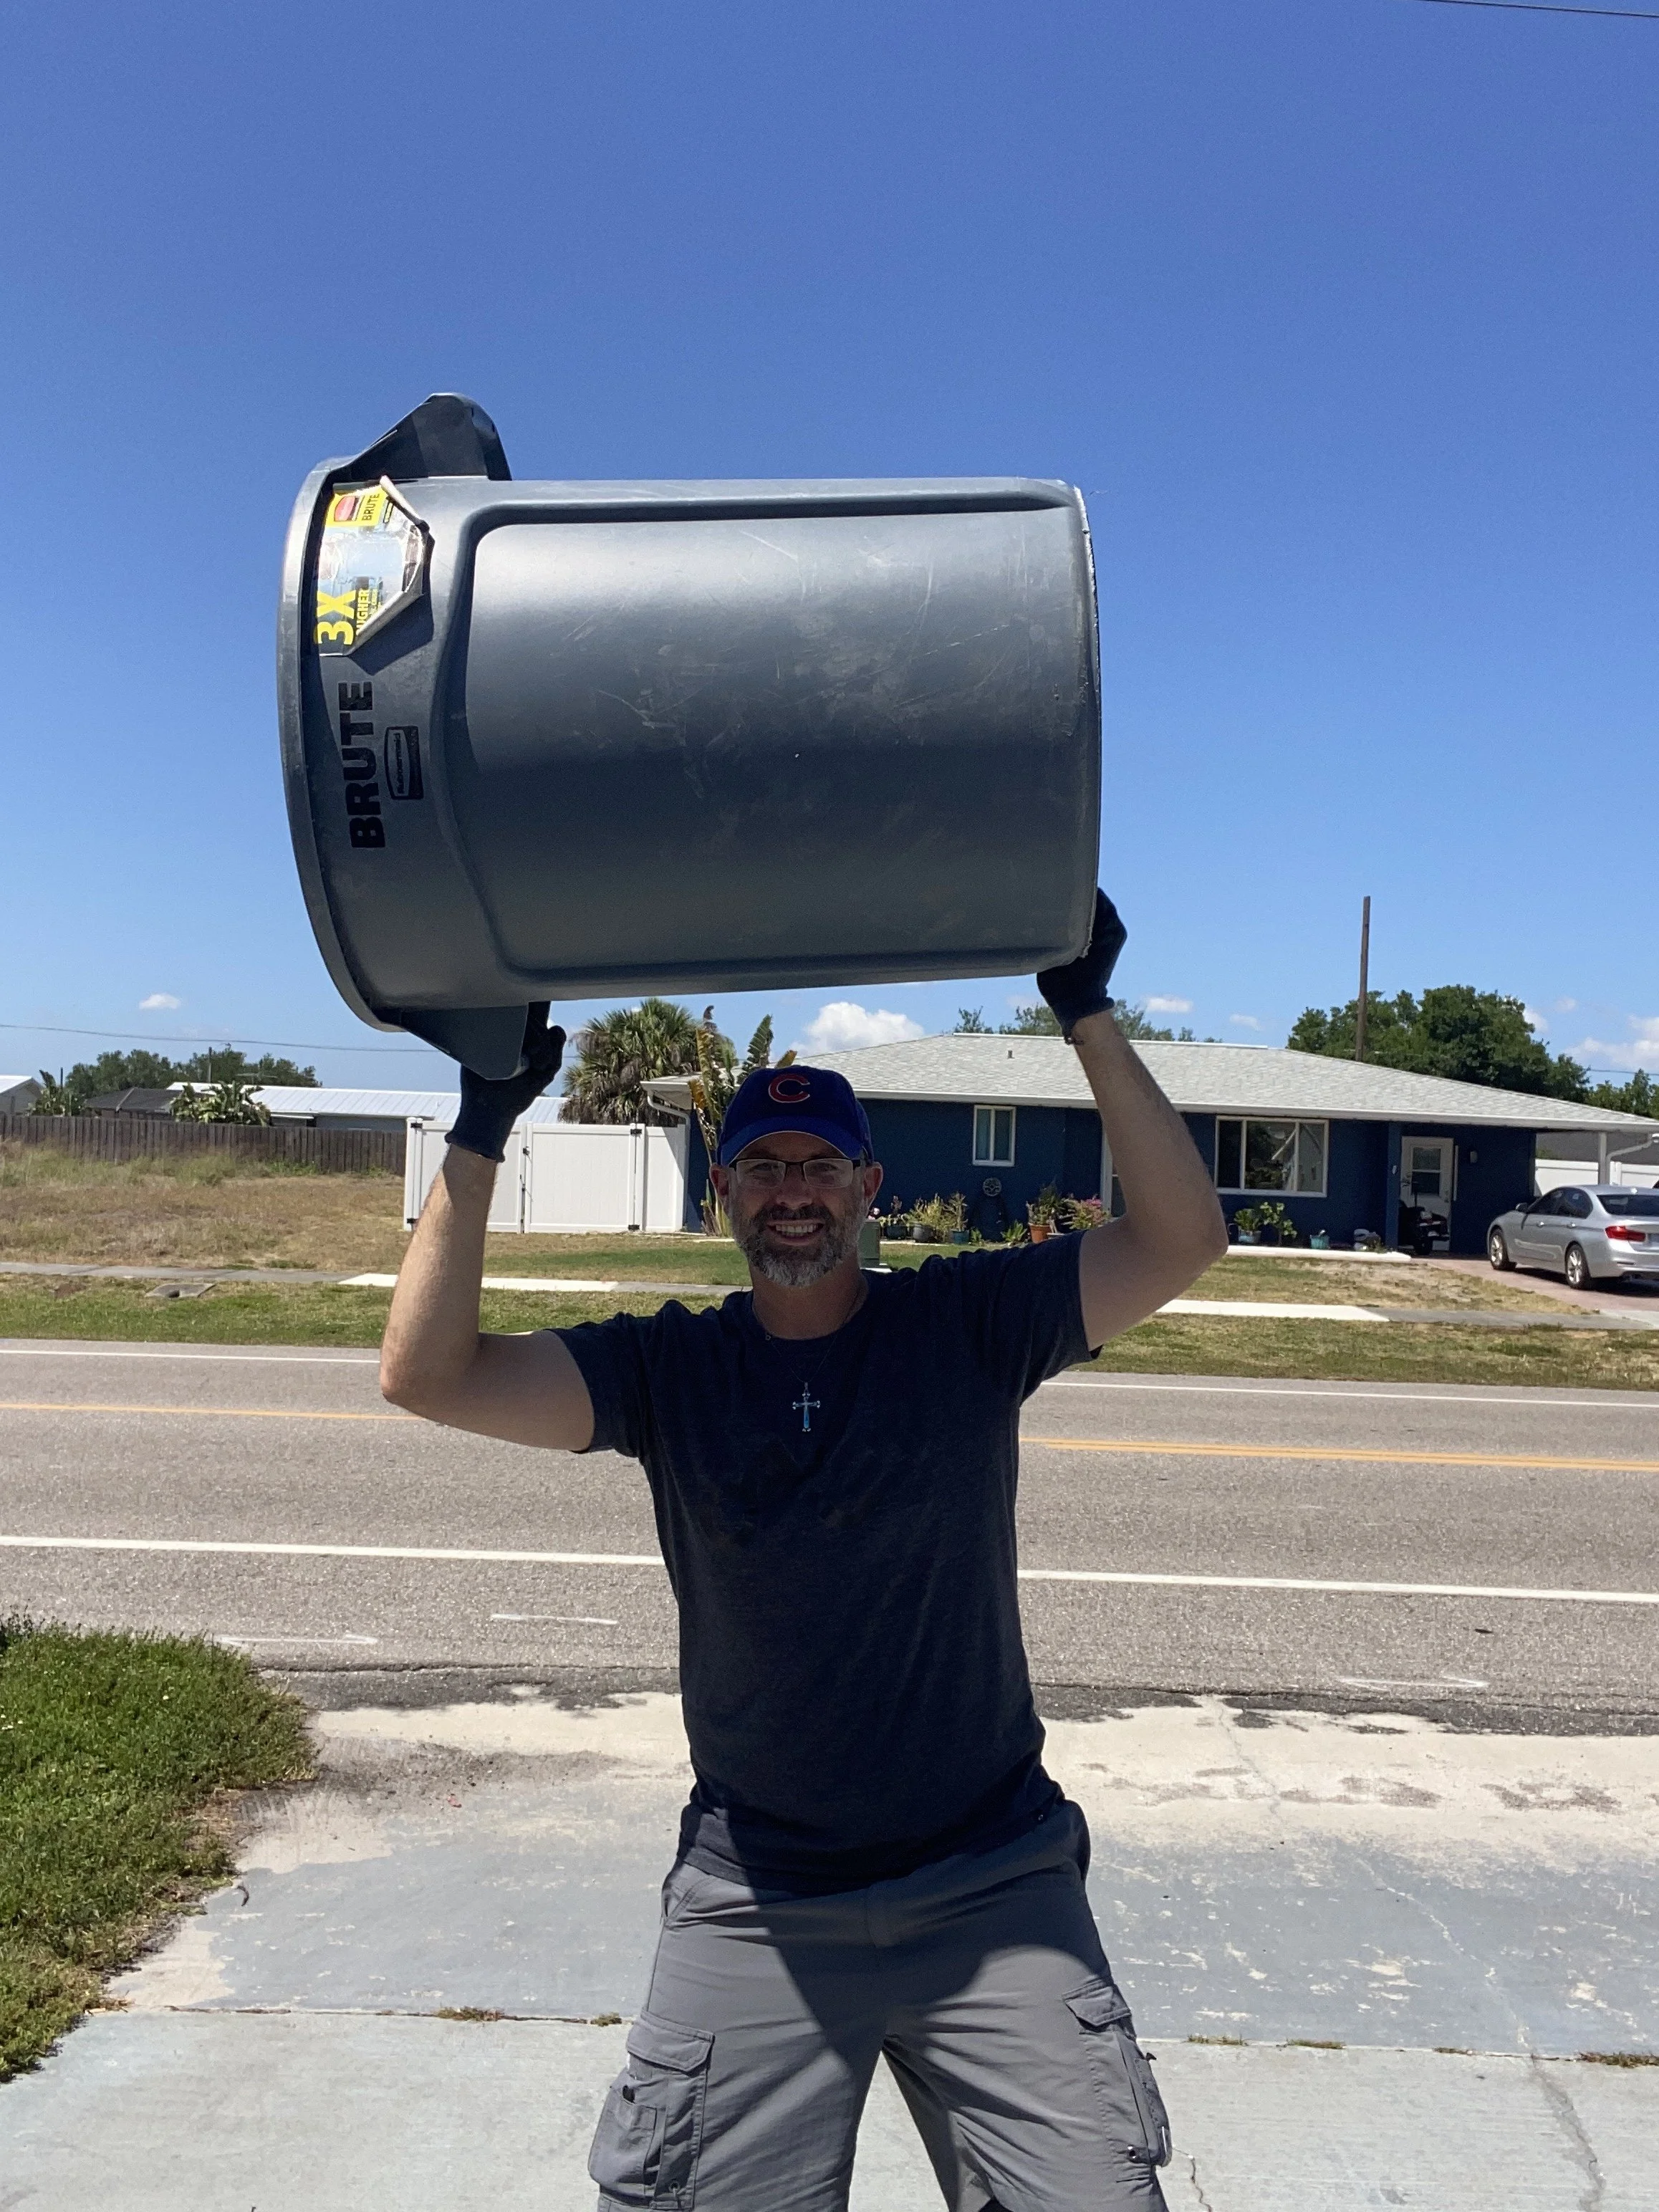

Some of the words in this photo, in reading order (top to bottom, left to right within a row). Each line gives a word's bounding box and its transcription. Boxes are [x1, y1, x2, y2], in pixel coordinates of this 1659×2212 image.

[361, 493, 380, 521] BRUTE
[317, 590, 357, 645] 3X
[356, 588, 370, 635] UGHER
[338, 681, 385, 848] BRUTE
[769, 1073, 810, 1103] C
